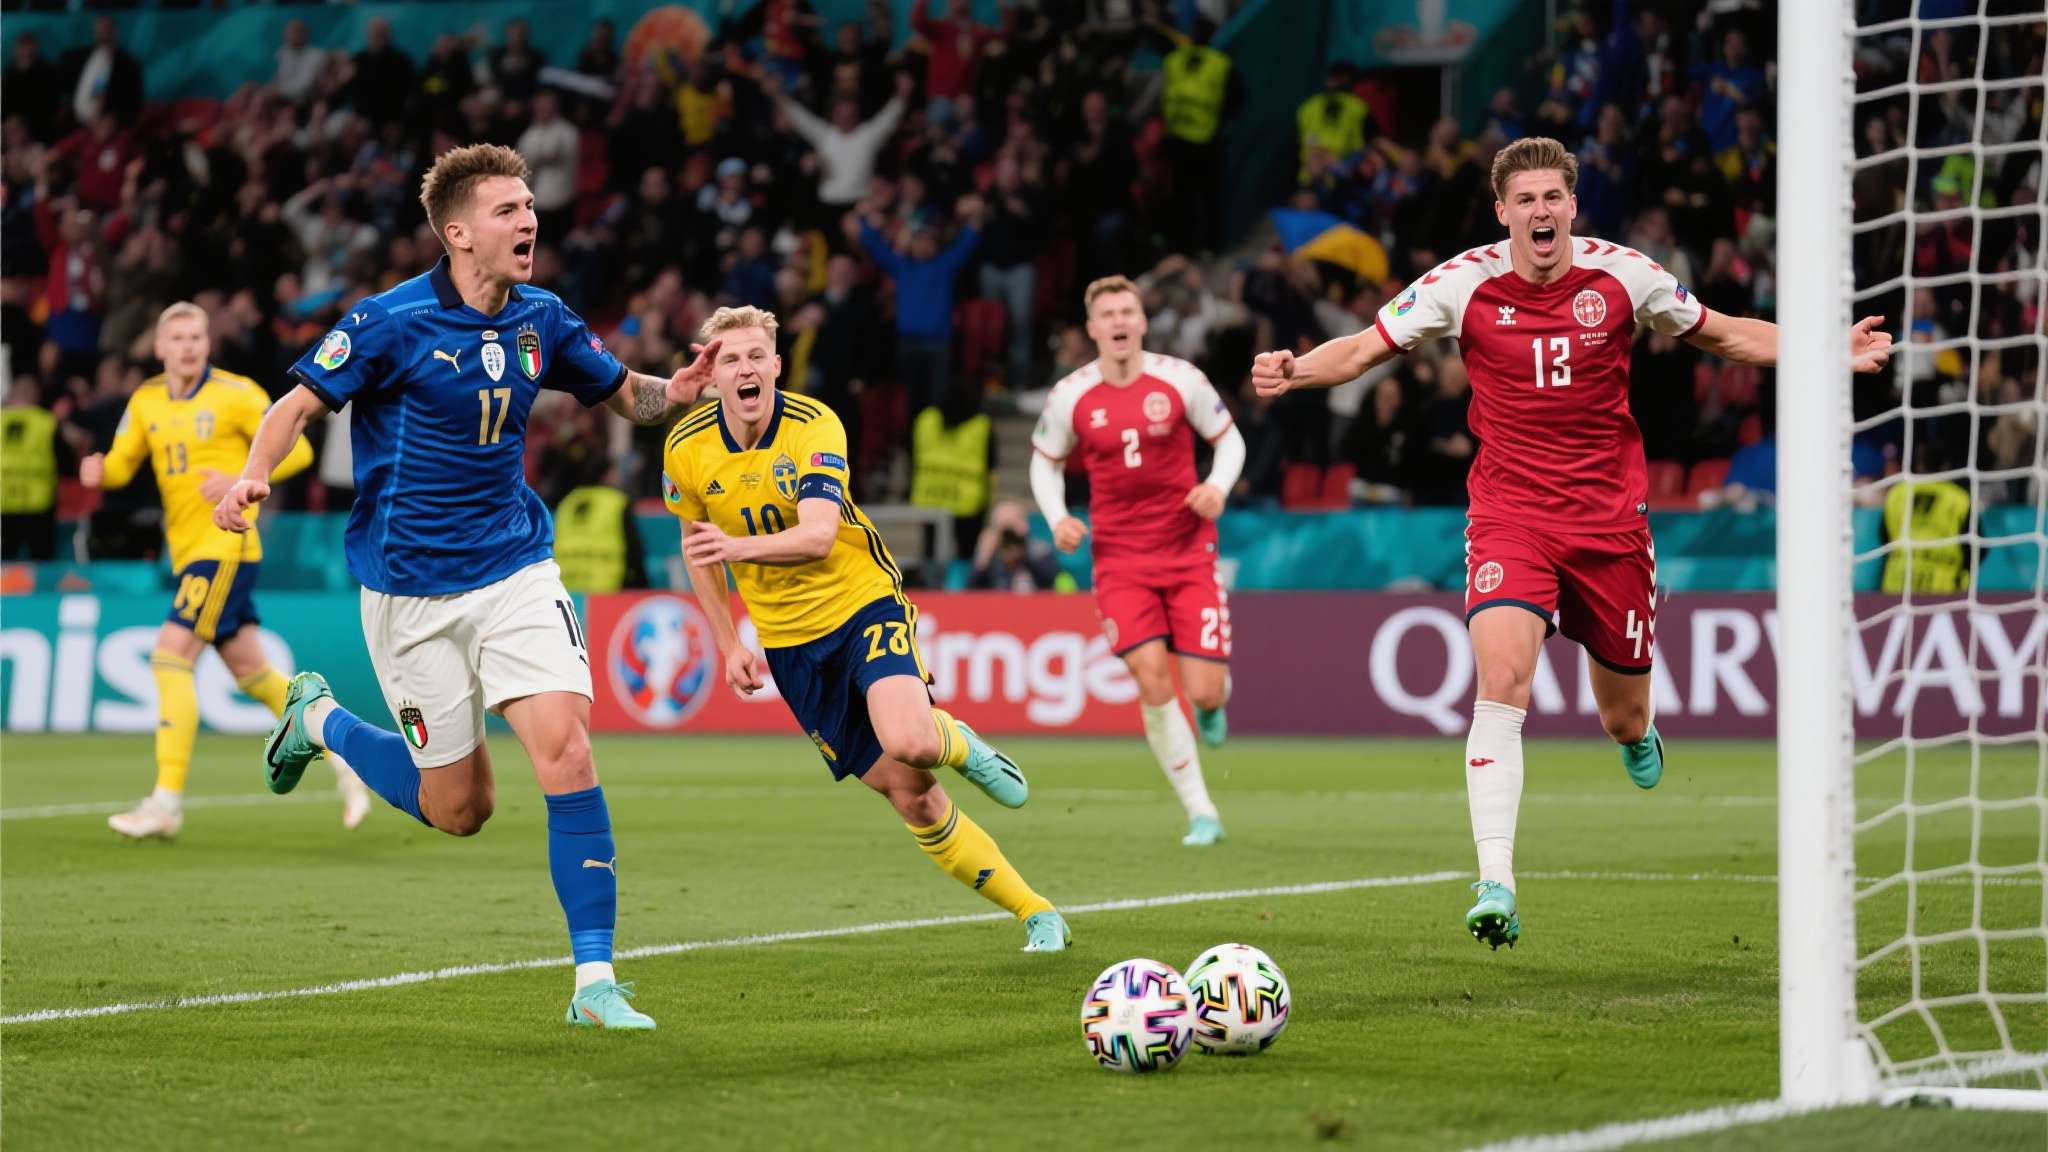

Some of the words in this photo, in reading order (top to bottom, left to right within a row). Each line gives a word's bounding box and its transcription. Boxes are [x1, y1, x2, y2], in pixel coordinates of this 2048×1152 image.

[1531, 336, 1571, 388] 13
[479, 387, 512, 446] 17
[1121, 427, 1142, 468] 2
[174, 573, 209, 621] 19
[1625, 609, 1644, 659] 4
